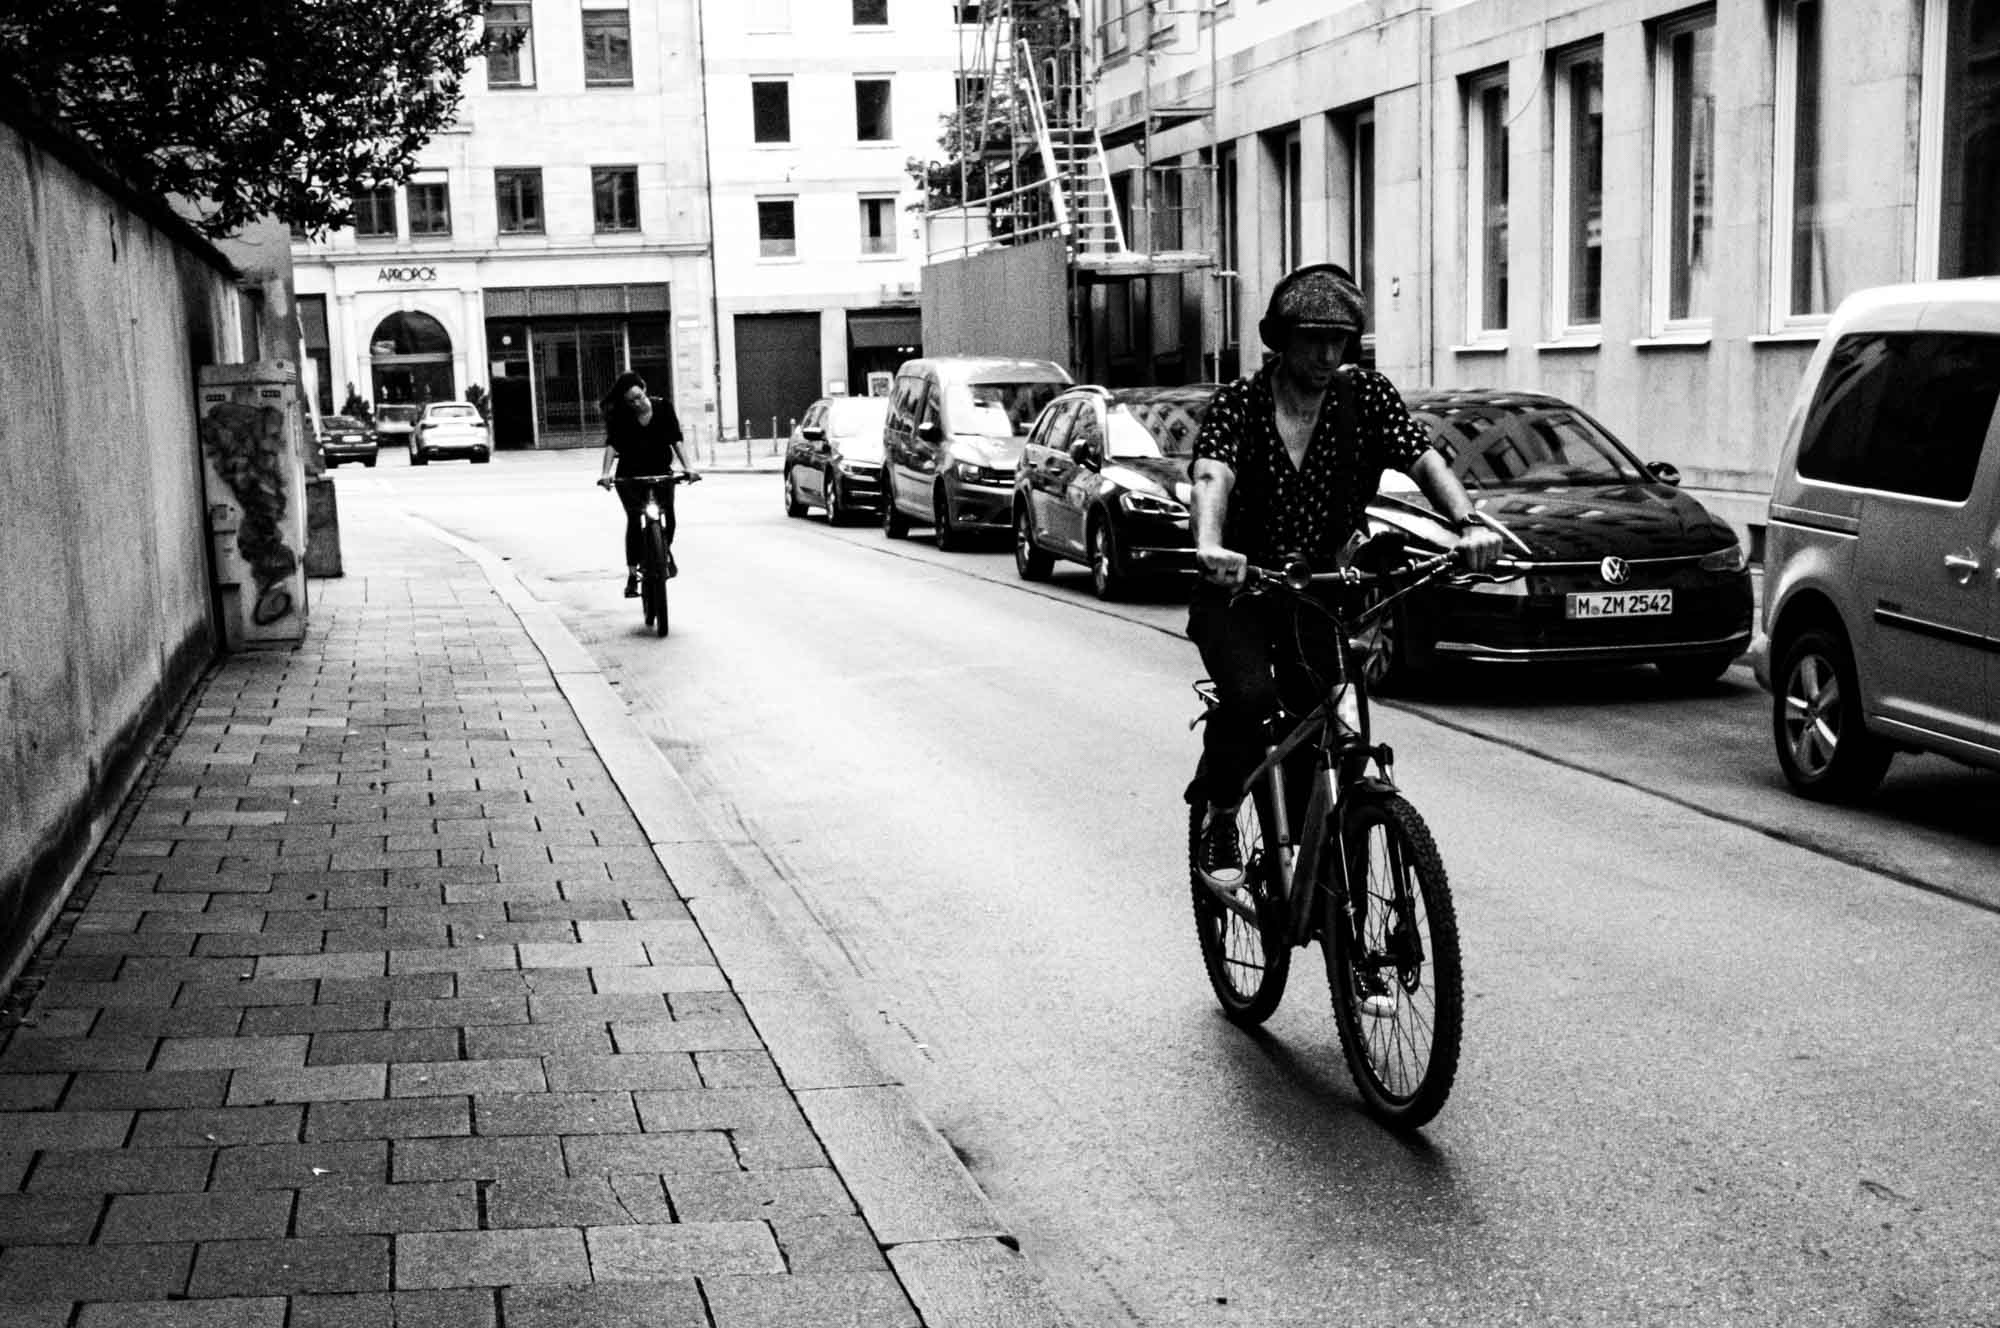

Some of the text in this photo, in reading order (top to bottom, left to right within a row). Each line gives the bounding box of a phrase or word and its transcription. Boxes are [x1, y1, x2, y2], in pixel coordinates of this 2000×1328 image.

[1578, 594, 1671, 615] M ZM 2542
